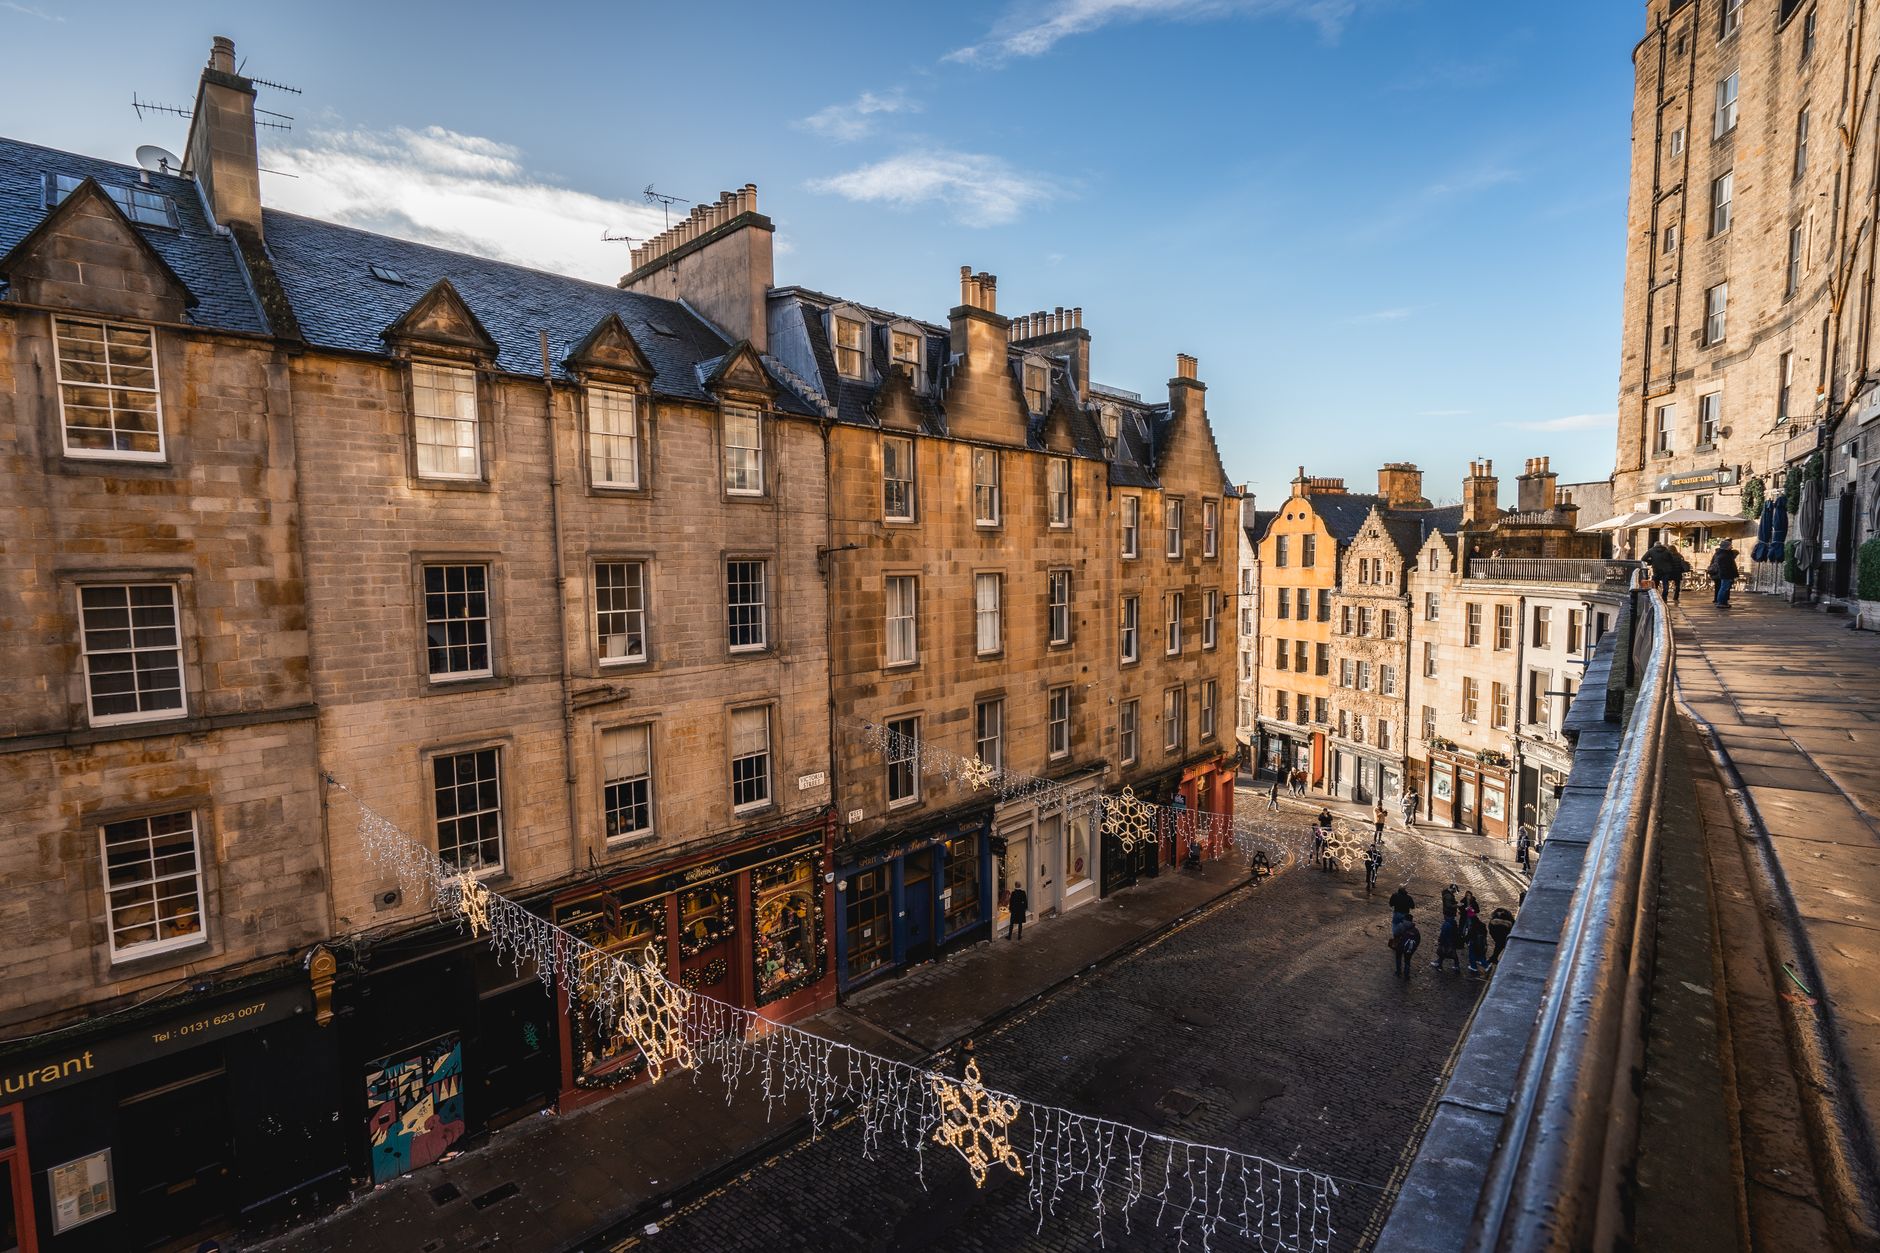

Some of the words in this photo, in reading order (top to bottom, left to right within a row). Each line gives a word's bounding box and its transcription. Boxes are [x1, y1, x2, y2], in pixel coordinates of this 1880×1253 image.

[801, 773, 823, 783] VICTORIA
[803, 779, 821, 788] STREET
[152, 1031, 170, 1043] Tel
[180, 1020, 210, 1035] 0131
[213, 1012, 236, 1025] 623
[238, 1002, 266, 1018] 0077
